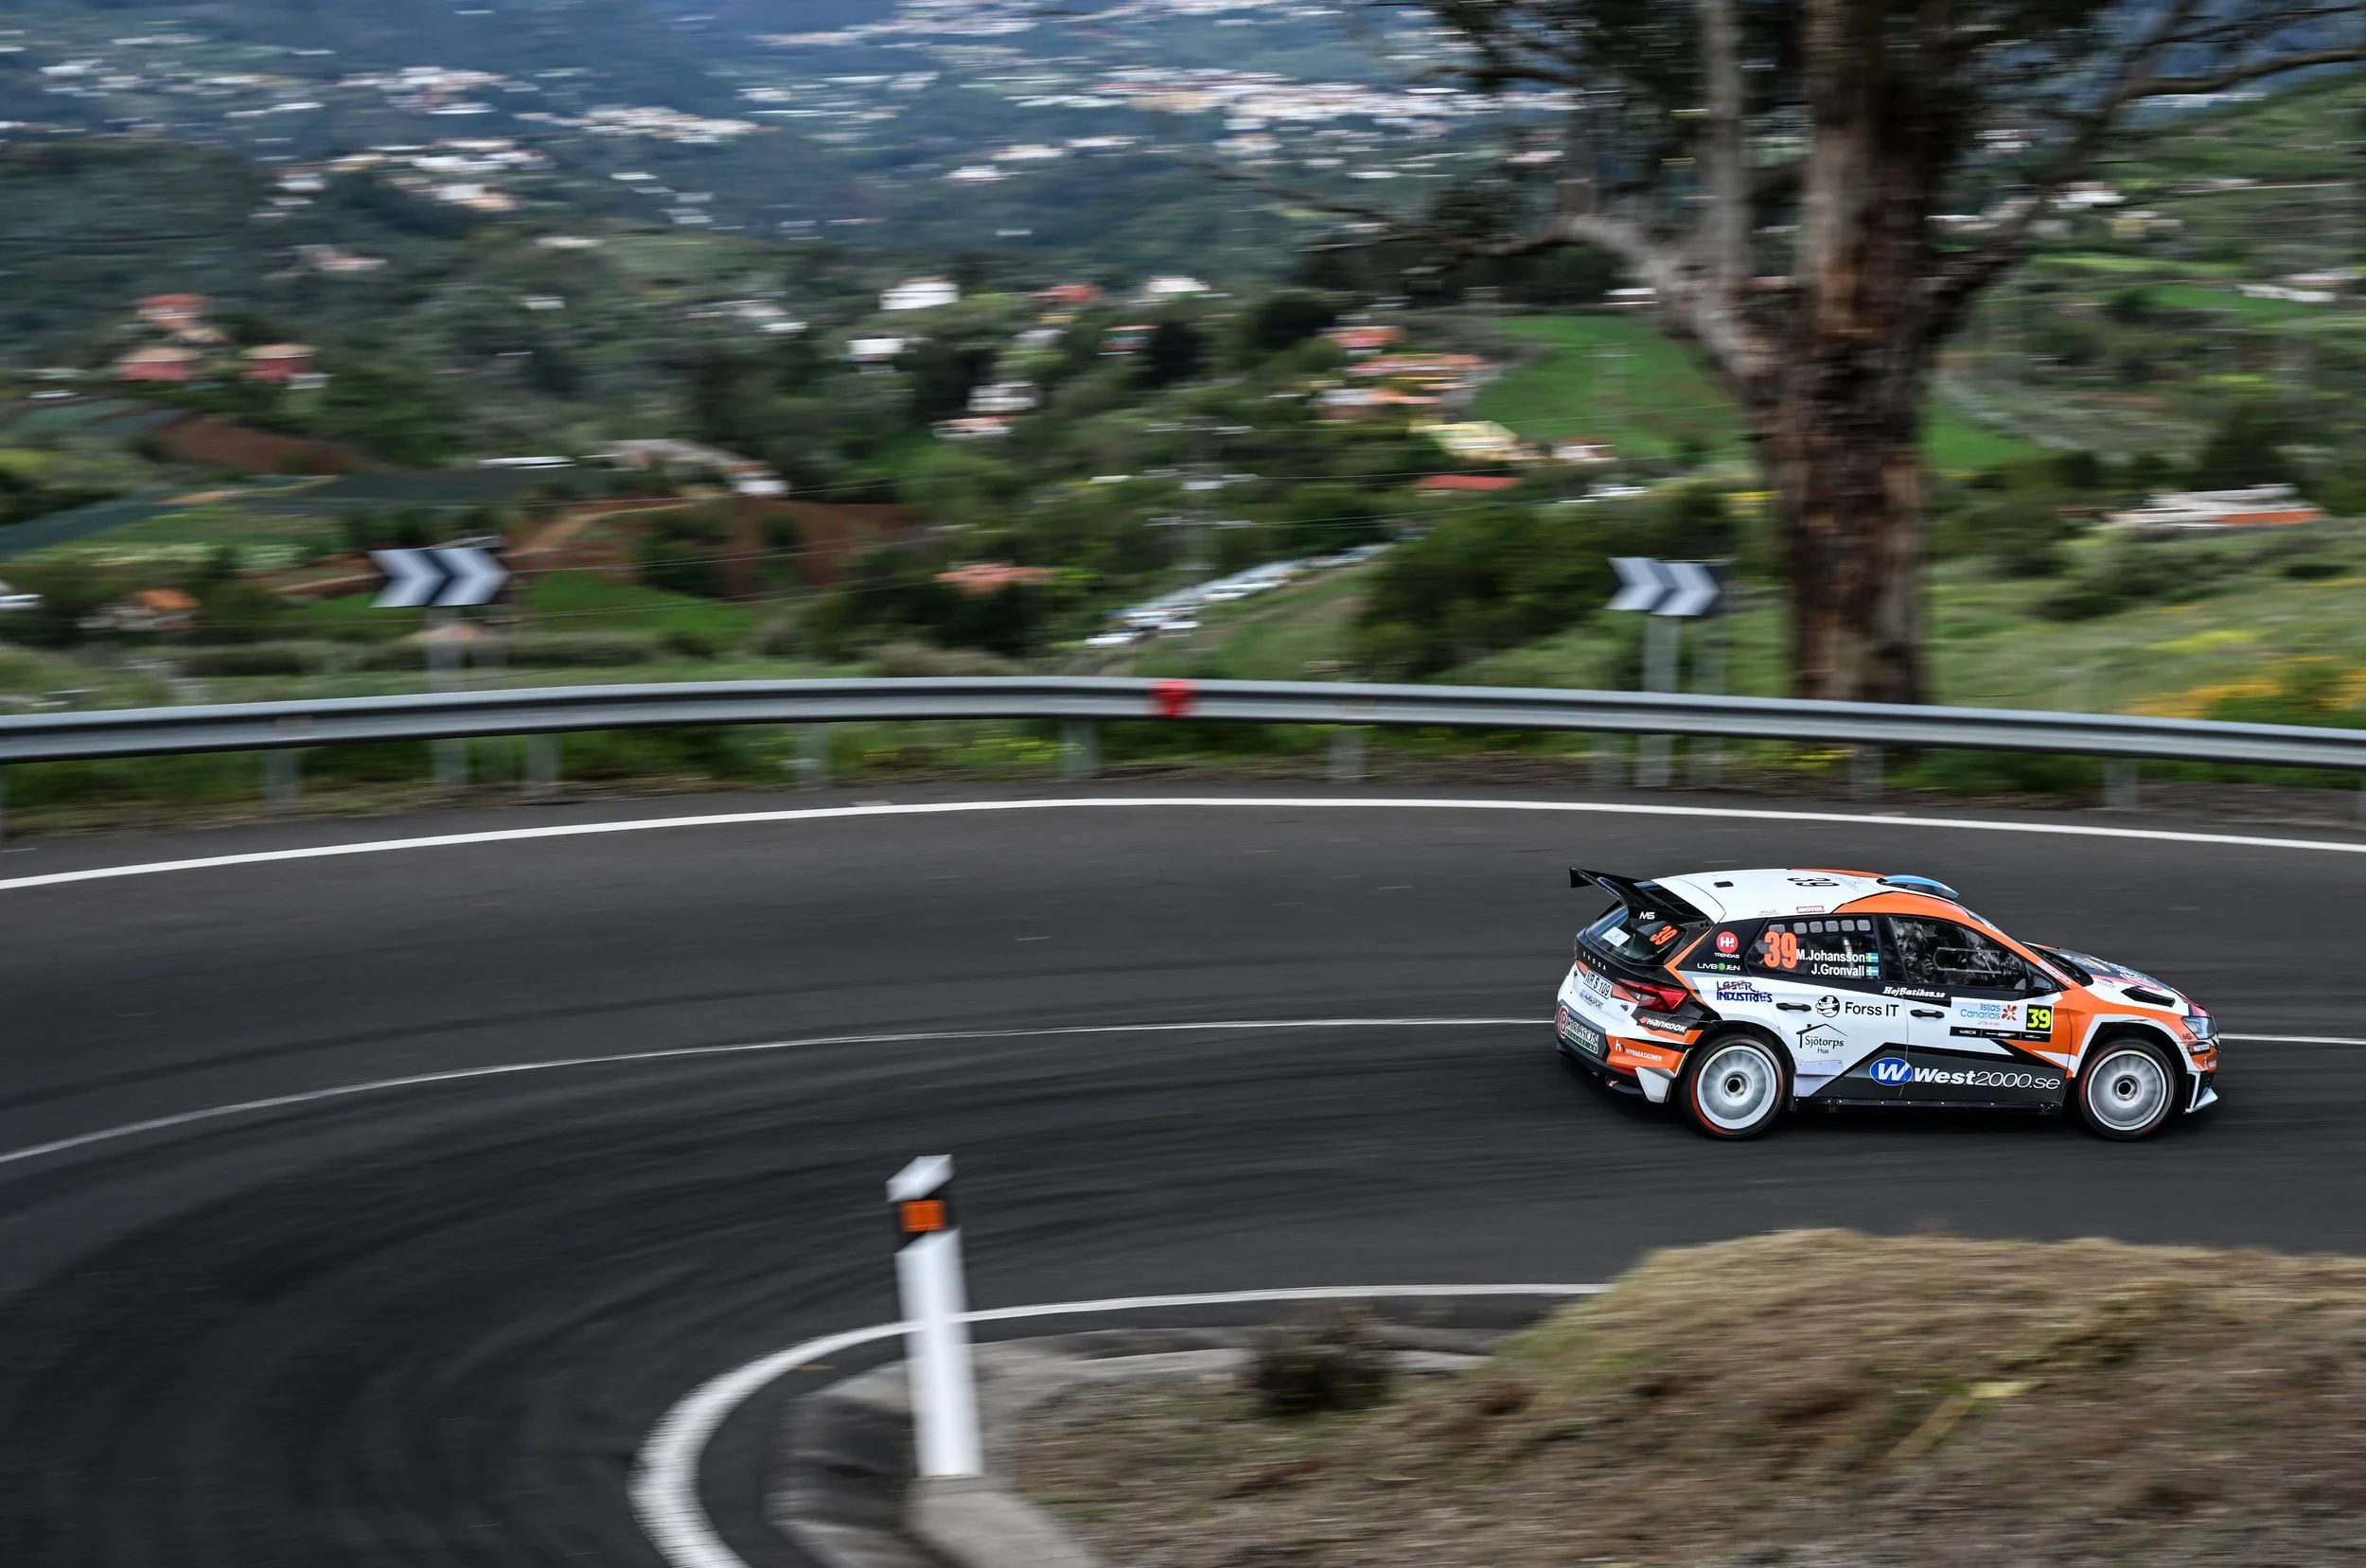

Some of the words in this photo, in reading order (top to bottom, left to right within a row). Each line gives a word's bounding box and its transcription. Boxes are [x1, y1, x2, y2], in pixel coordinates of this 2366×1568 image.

[1650, 925, 1680, 945] 39
[1764, 931, 1797, 969] 39
[1796, 948, 1865, 962] M.Johansson
[1811, 963, 1865, 977] J.Gronvall
[1845, 1001, 1882, 1016] Forss
[1885, 1004, 1899, 1017] IT
[1960, 1009, 2002, 1020] Canarias
[1980, 1003, 2002, 1013] Islas
[2026, 1008, 2051, 1029] 39
[1805, 1034, 1845, 1048] Sjötorps
[1878, 1063, 1909, 1082] W
[1913, 1067, 2061, 1090] West2000.se
